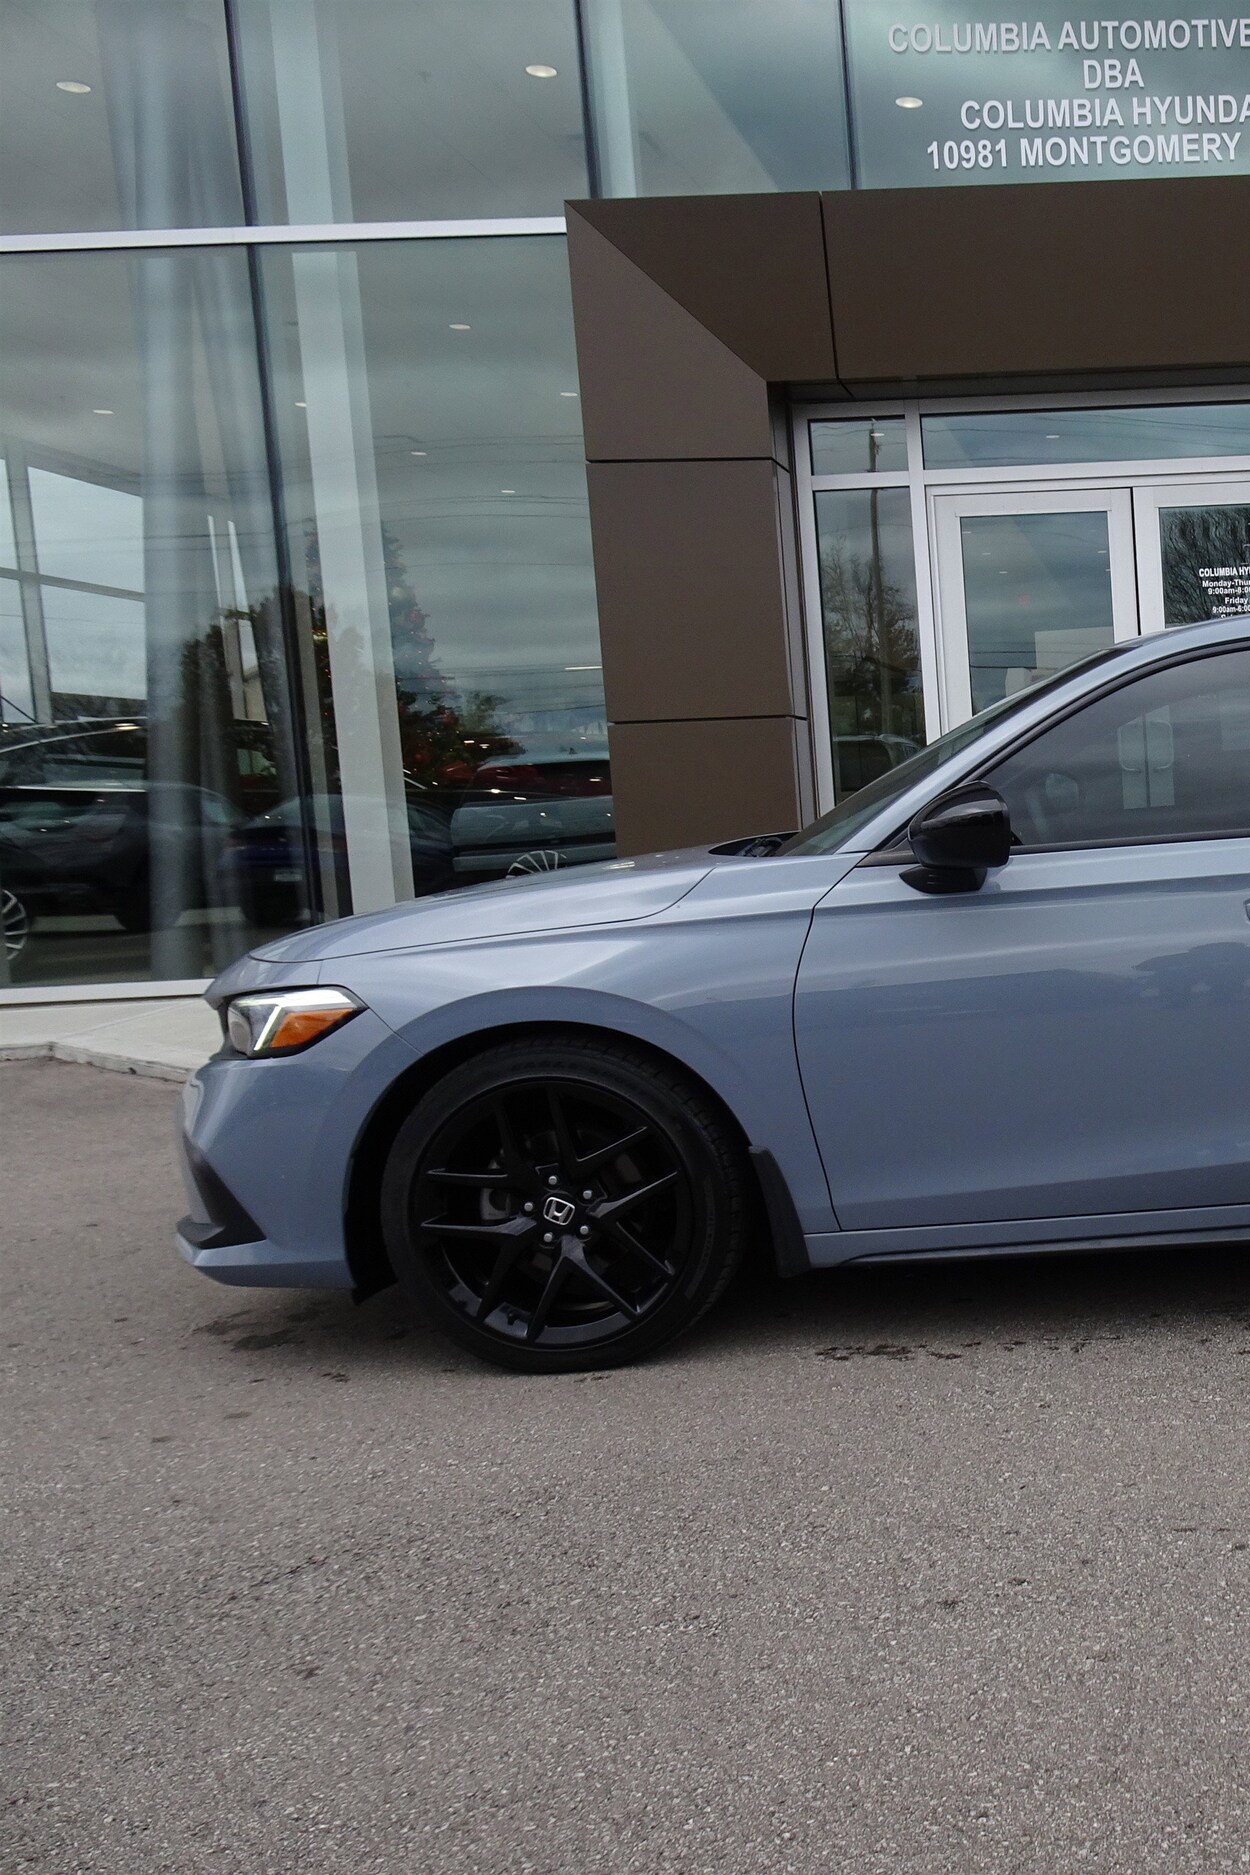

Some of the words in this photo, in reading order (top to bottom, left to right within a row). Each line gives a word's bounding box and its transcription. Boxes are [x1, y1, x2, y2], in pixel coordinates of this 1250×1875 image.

[887, 21, 1051, 52] COLUMBIA
[1083, 58, 1145, 89] DBA
[960, 97, 1124, 130] COLUMBIA
[926, 139, 1008, 170] 10981
[1020, 132, 1241, 166] MONTGOMERY
[1199, 567, 1238, 577] COLUMBIA
